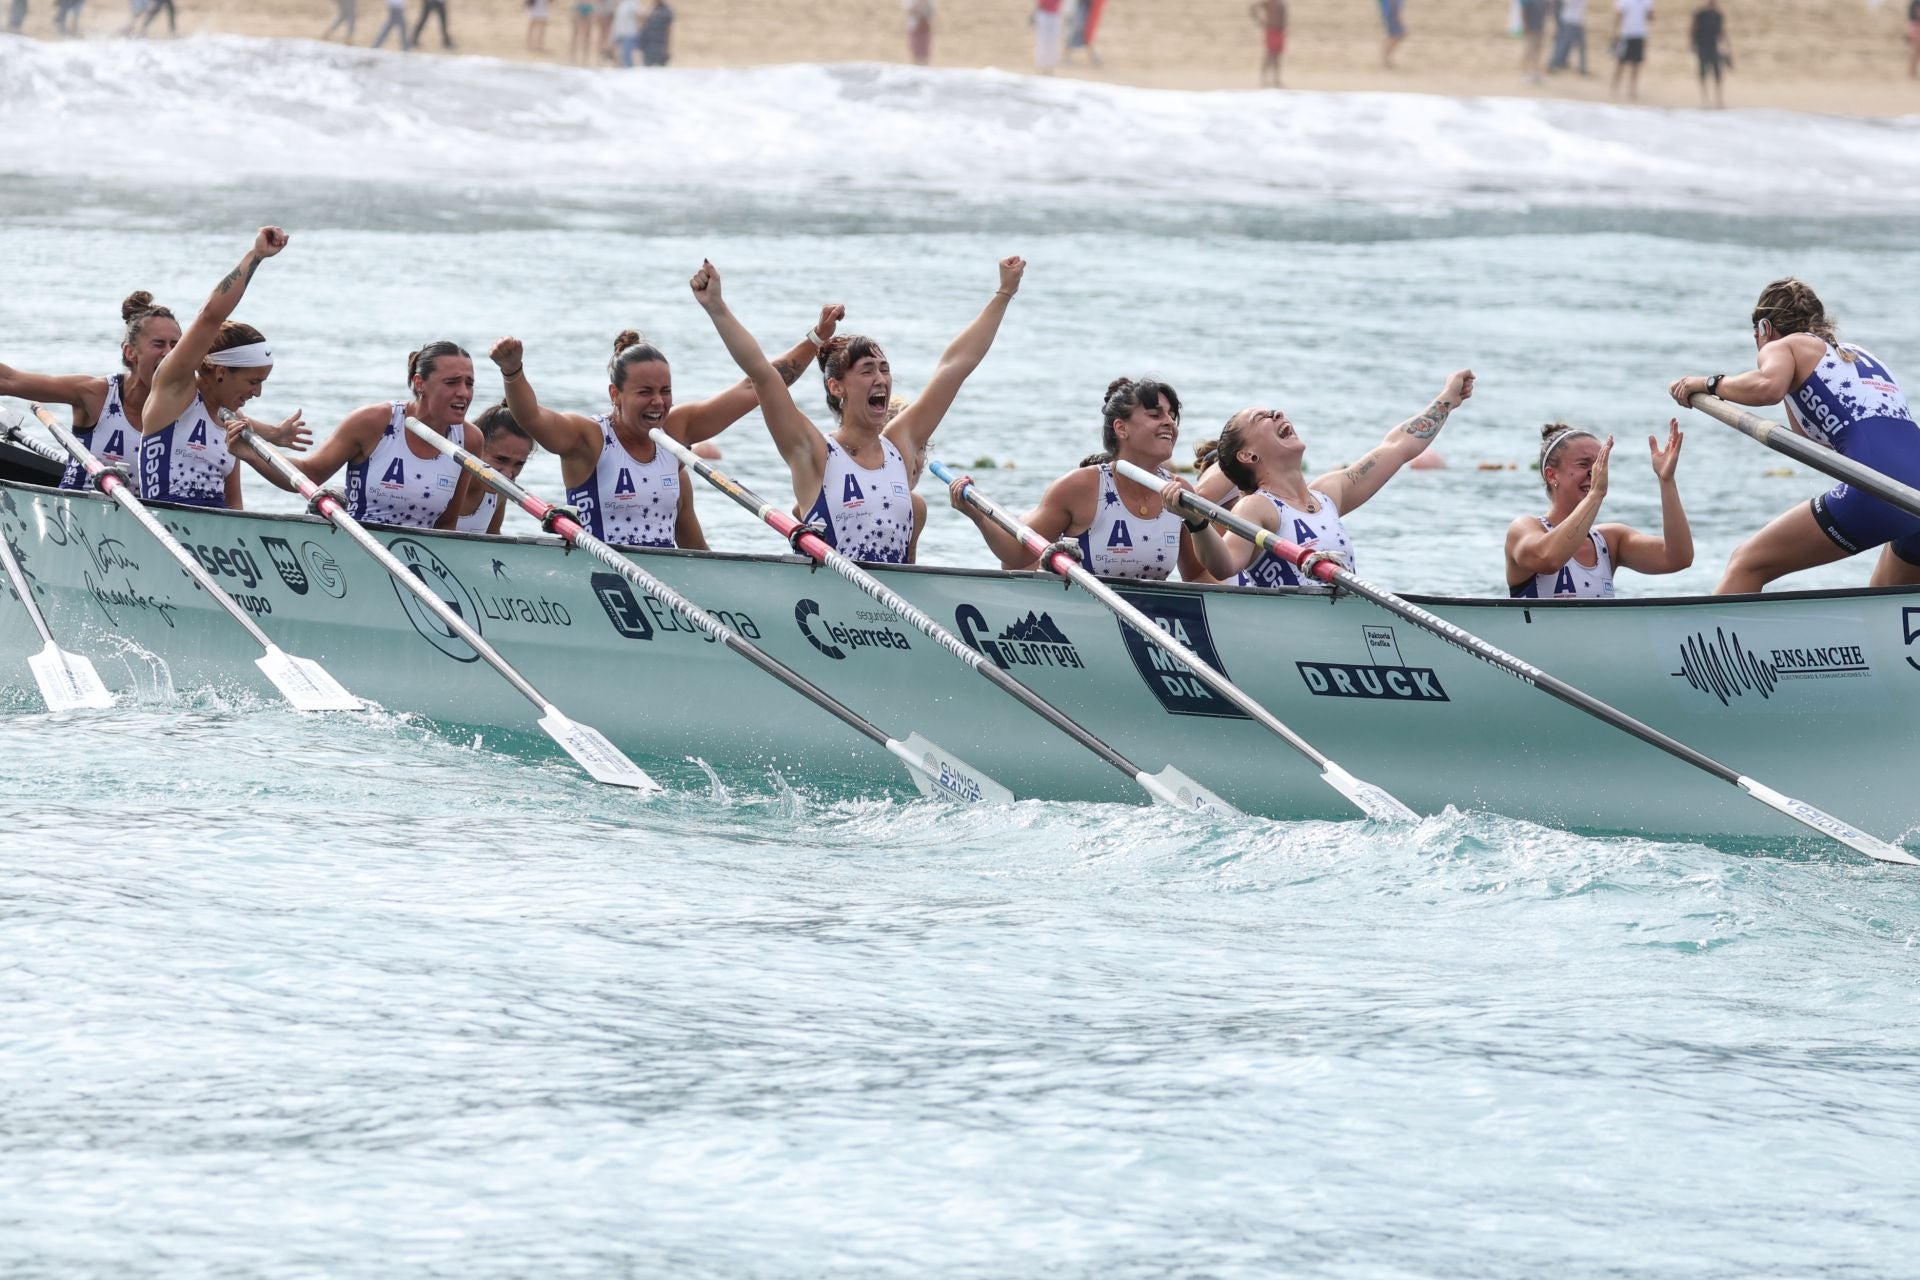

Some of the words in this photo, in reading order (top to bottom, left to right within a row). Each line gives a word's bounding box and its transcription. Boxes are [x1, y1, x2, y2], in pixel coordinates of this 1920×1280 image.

[1800, 385, 1849, 435] asegi
[1107, 520, 1133, 547] A
[1827, 526, 1857, 551] DONOSTIA
[473, 586, 572, 626] Lurauto
[856, 610, 898, 623] seguridad
[1368, 631, 1391, 640] Faktoria
[1771, 645, 1865, 668] ENSANCHE
[1161, 675, 1214, 699] DIA
[1302, 666, 1443, 697] DRUCK
[941, 761, 981, 795] CLINICA
